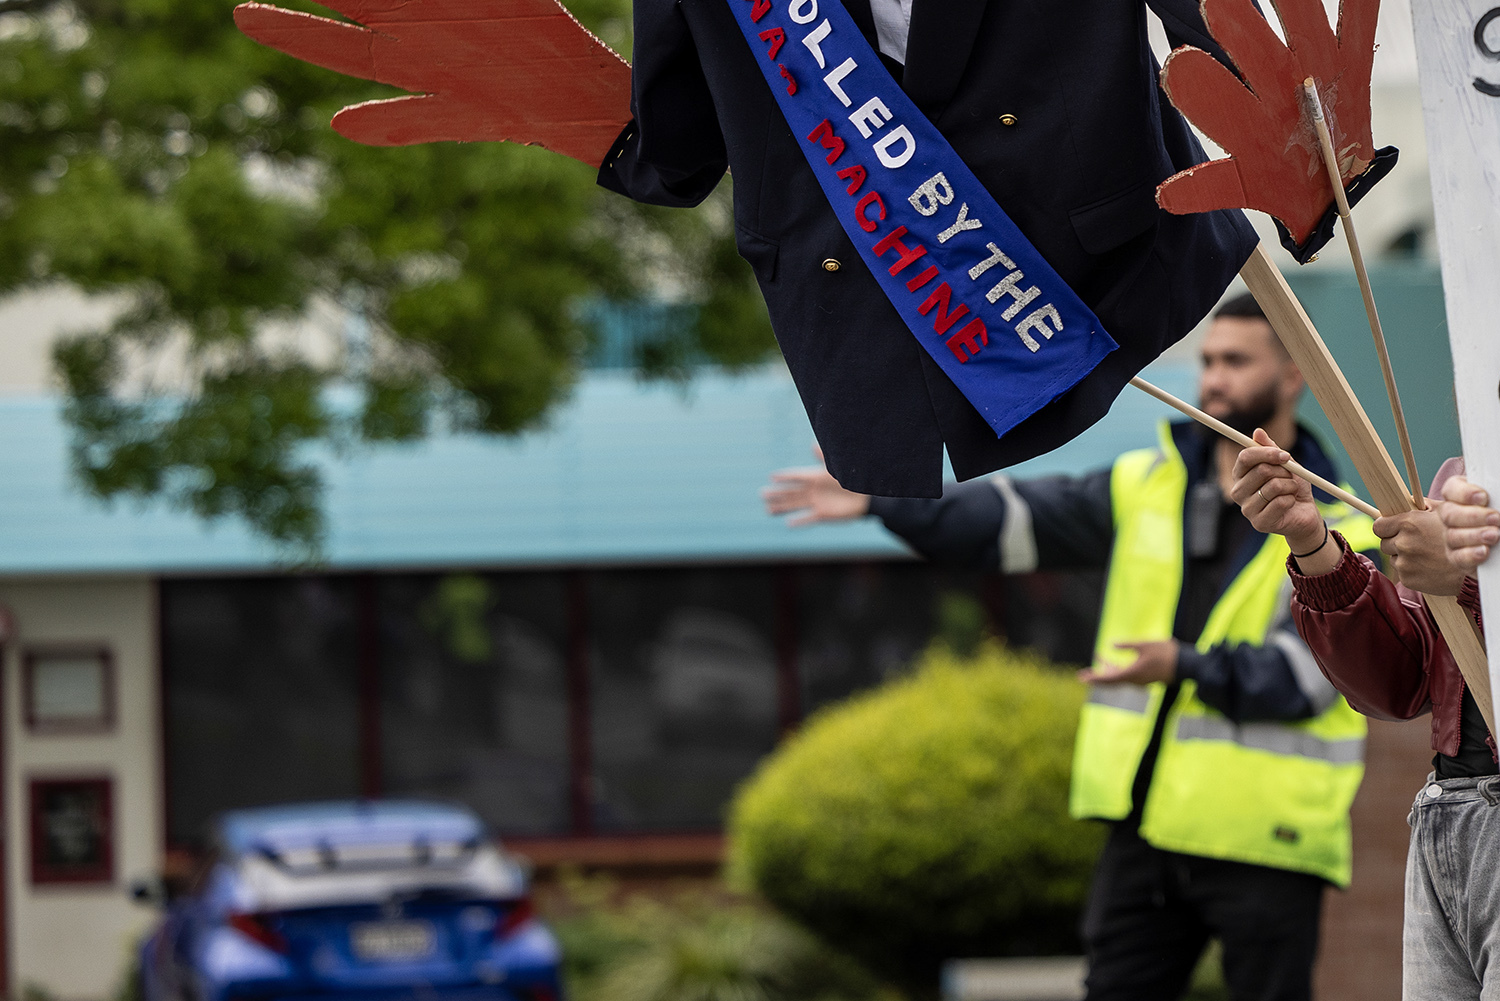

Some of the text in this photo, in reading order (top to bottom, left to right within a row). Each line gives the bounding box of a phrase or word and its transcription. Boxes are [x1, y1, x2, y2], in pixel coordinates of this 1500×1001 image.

[807, 118, 989, 365] MACHINE
[907, 171, 983, 245] BY
[968, 241, 1064, 354] THE
